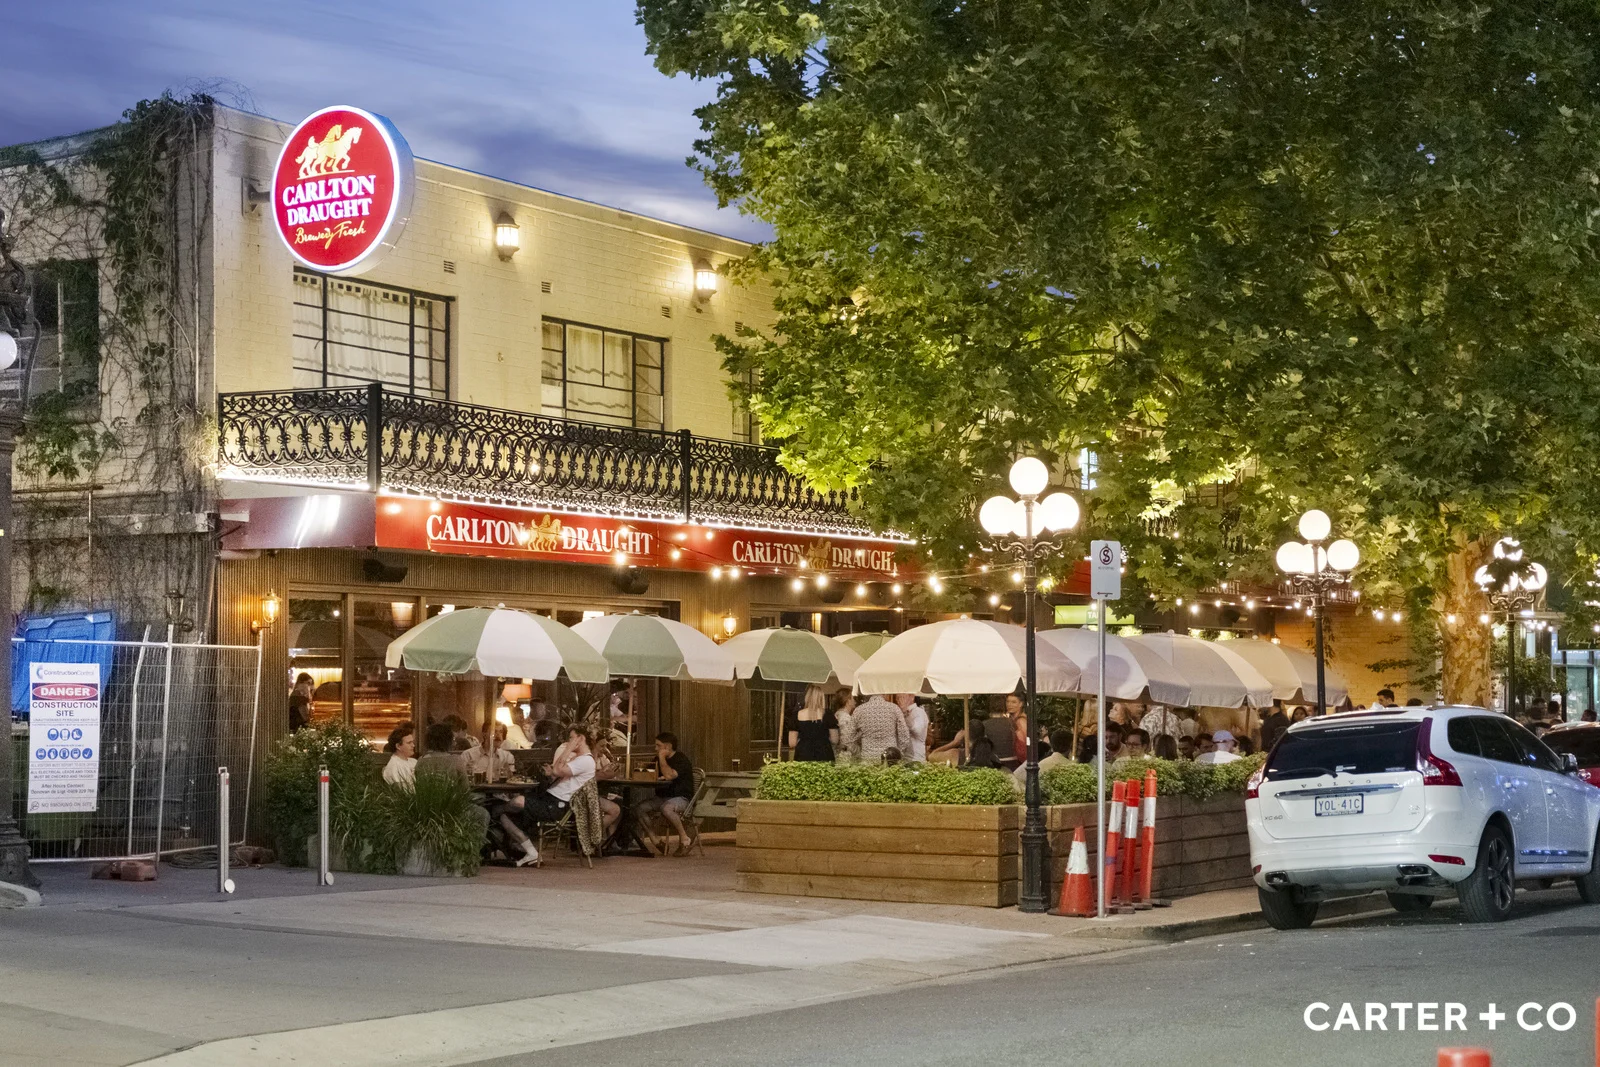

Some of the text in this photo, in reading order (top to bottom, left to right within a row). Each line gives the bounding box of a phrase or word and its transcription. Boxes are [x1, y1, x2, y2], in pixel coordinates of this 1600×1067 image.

[282, 174, 376, 207] CARLTON
[286, 197, 372, 226] DRAUGHT
[294, 220, 367, 249] Brewery Fresh
[426, 514, 653, 555] CARLTON DRAUGHT
[732, 540, 805, 566] CARLTON
[32, 701, 98, 709] CONSTRUCTION
[40, 687, 91, 696] DANGER
